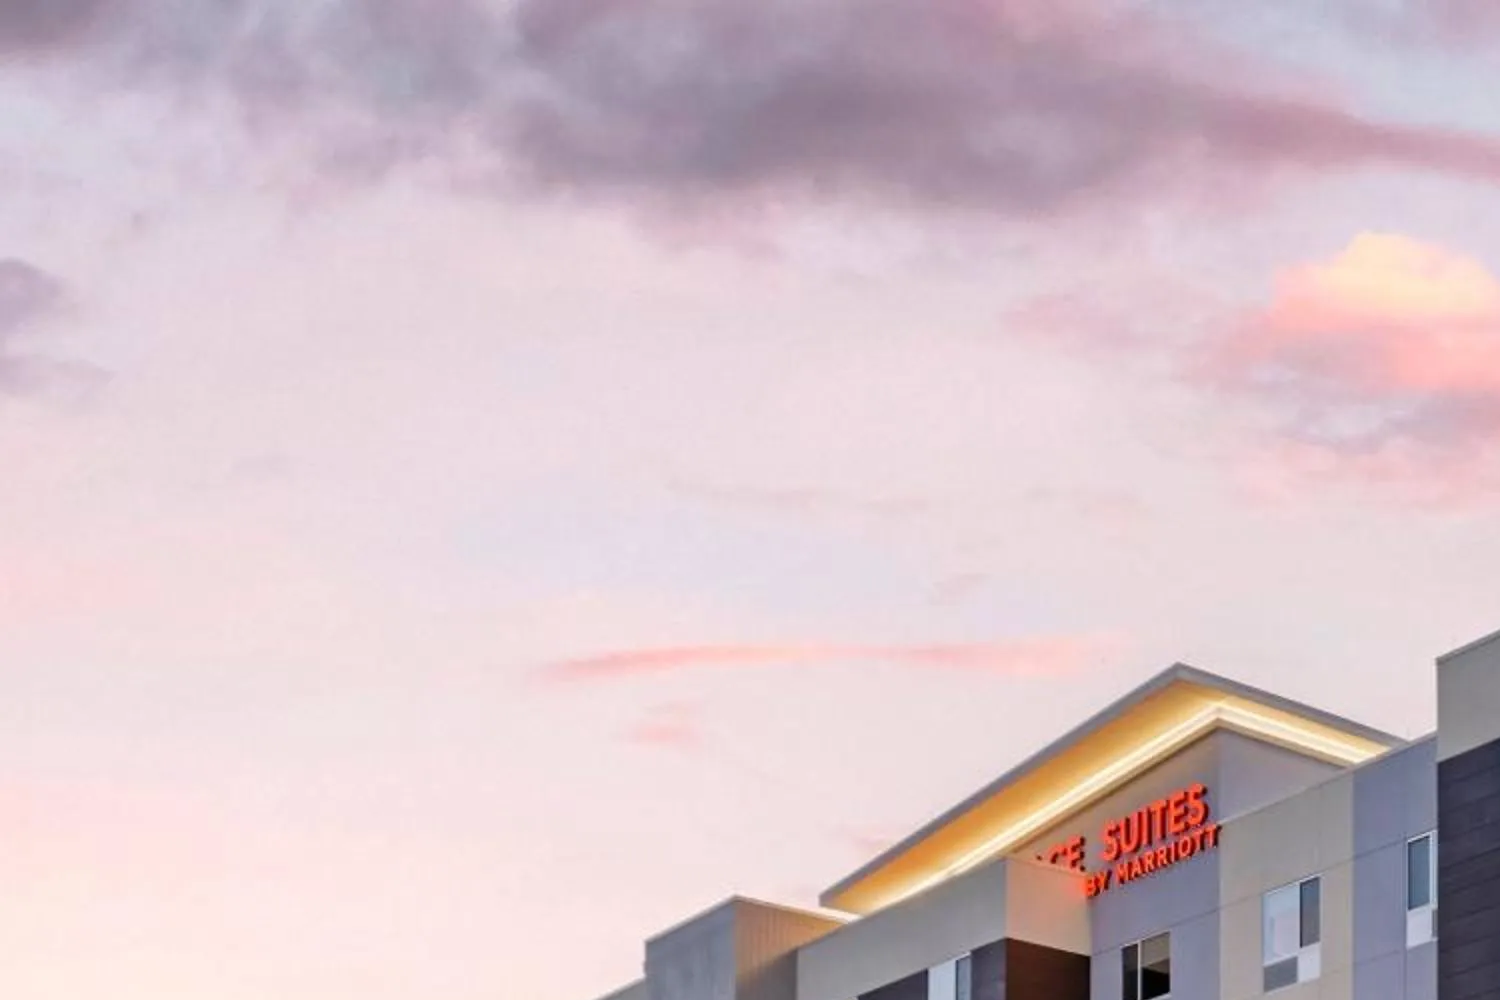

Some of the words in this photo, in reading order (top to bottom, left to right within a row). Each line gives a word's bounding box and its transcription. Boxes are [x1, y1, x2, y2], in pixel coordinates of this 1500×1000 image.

[1101, 783, 1209, 861] SUITES
[1081, 870, 1112, 898] BY
[1116, 824, 1221, 884] MARRIOTT
